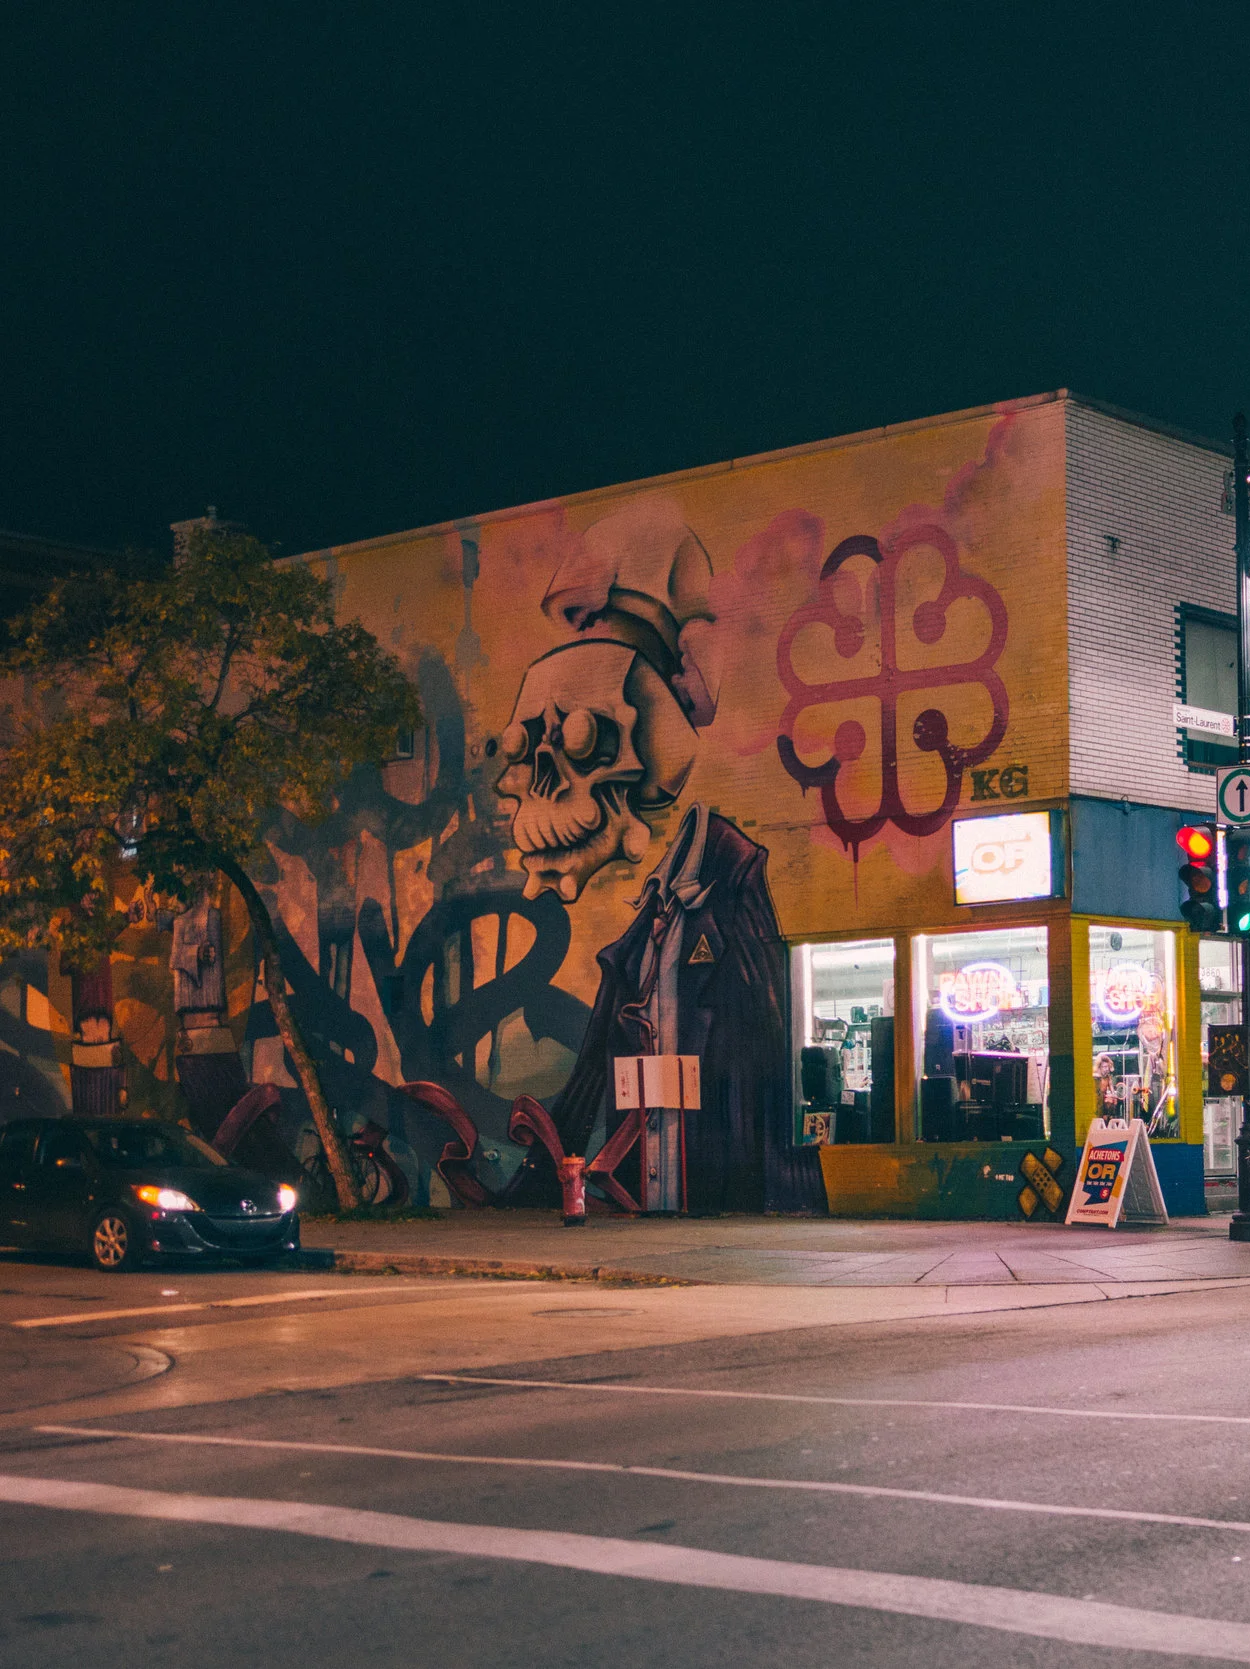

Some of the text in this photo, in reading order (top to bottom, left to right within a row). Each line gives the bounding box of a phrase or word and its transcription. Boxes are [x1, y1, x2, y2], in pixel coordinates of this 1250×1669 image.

[1176, 711, 1221, 731] Saint-Laurent
[970, 764, 1029, 801] KG
[1107, 989, 1158, 1012] SHOP
[1088, 1150, 1121, 1161] ACHETONS
[1088, 1163, 1116, 1179] OR
